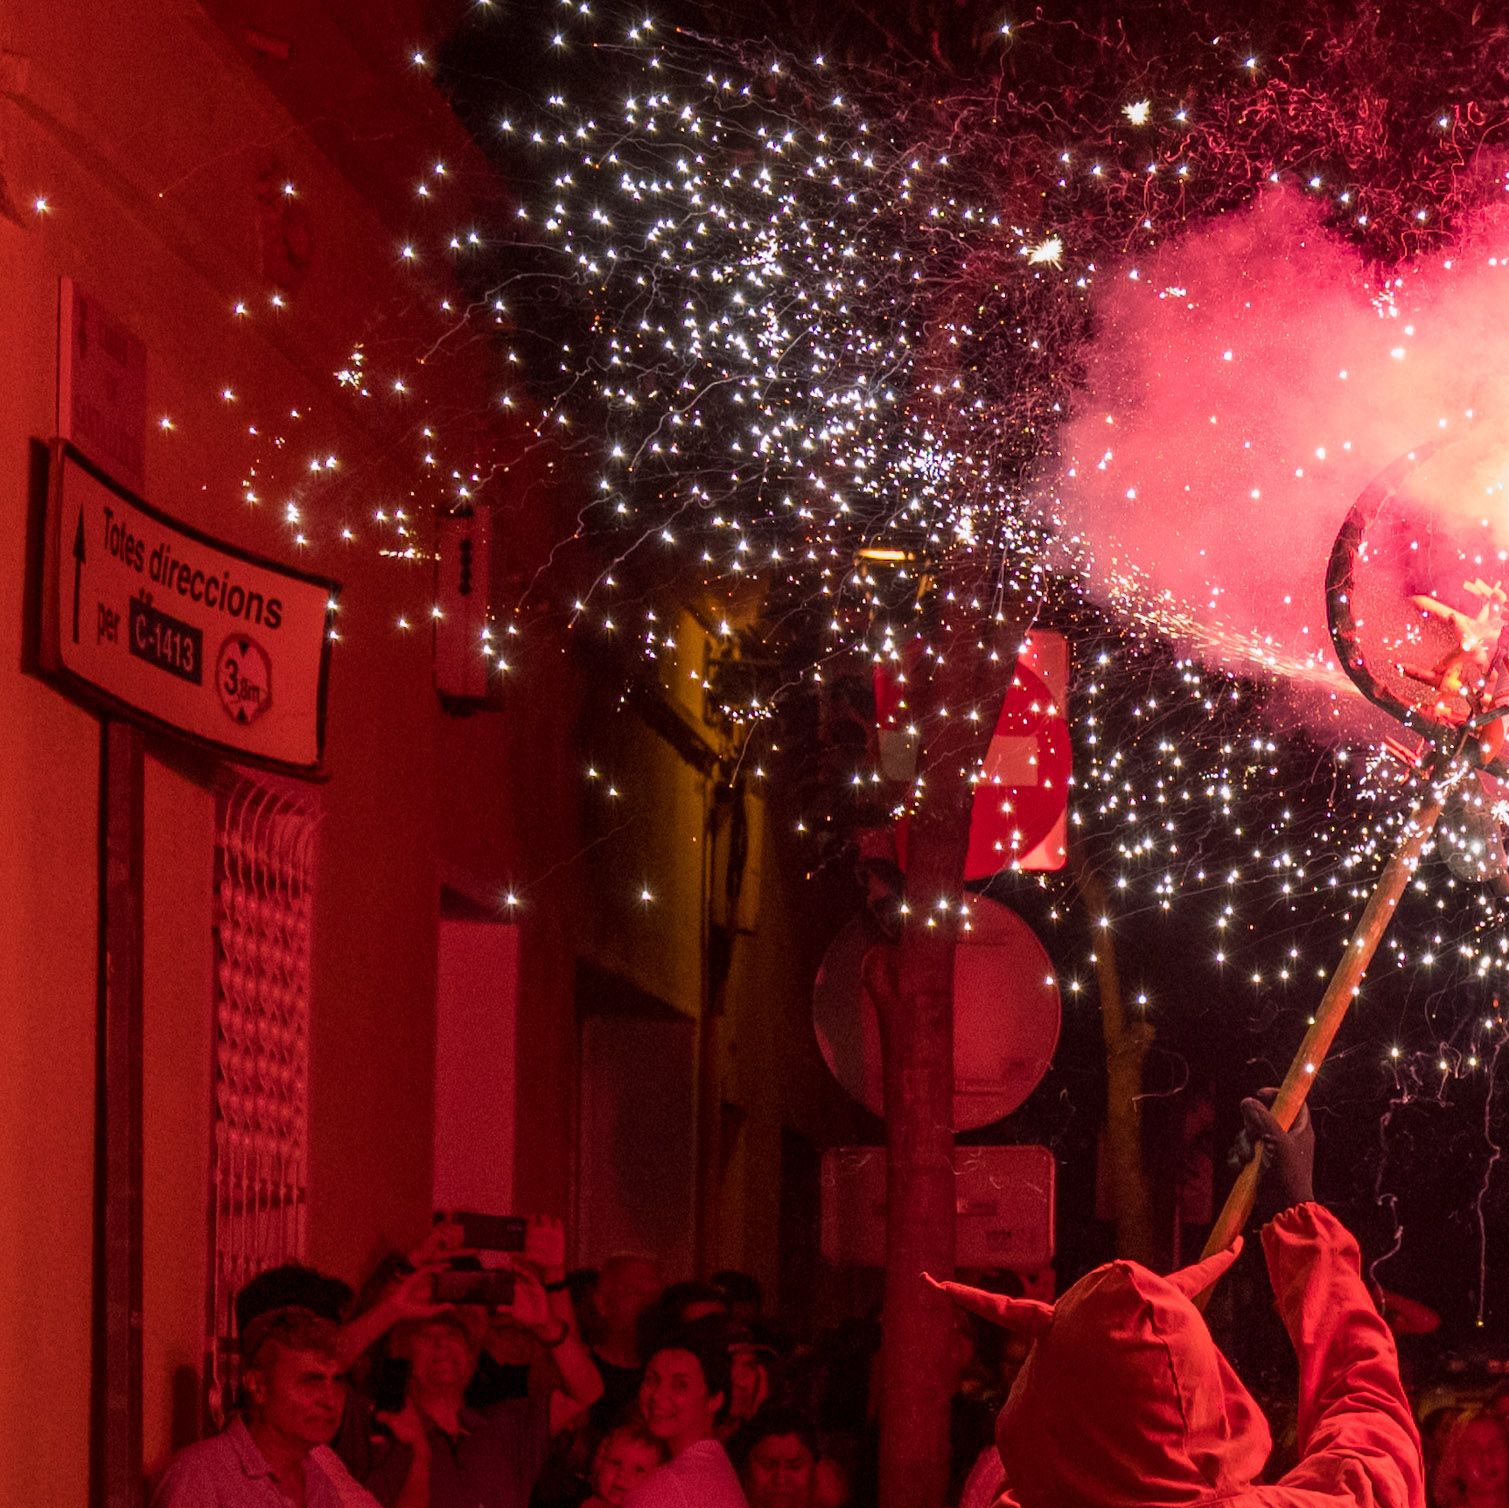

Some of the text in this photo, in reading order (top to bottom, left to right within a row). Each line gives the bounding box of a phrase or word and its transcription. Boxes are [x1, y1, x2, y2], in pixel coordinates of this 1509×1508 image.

[104, 506, 282, 629] Totes direccions
[97, 602, 194, 673] per C-1413
